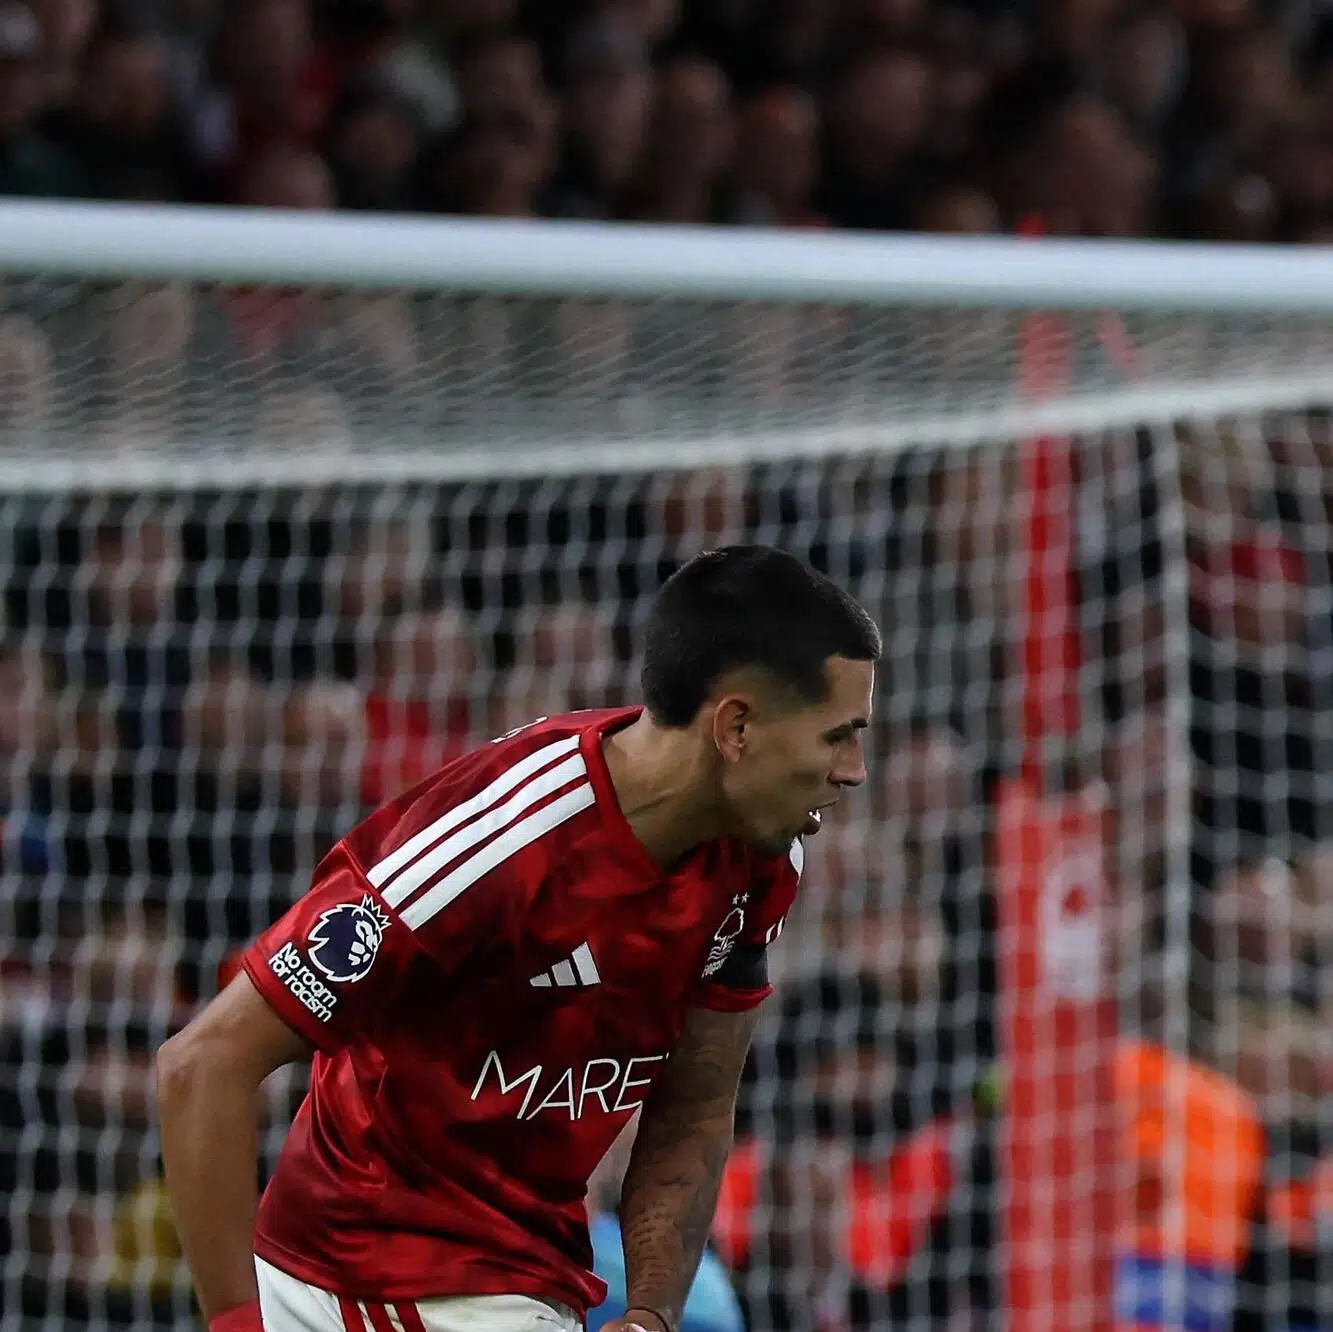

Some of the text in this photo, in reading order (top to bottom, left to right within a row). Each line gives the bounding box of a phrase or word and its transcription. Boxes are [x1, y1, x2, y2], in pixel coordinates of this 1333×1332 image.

[280, 941, 338, 1008] No room
[283, 973, 333, 1023] racism
[470, 1049, 670, 1121] MARE
